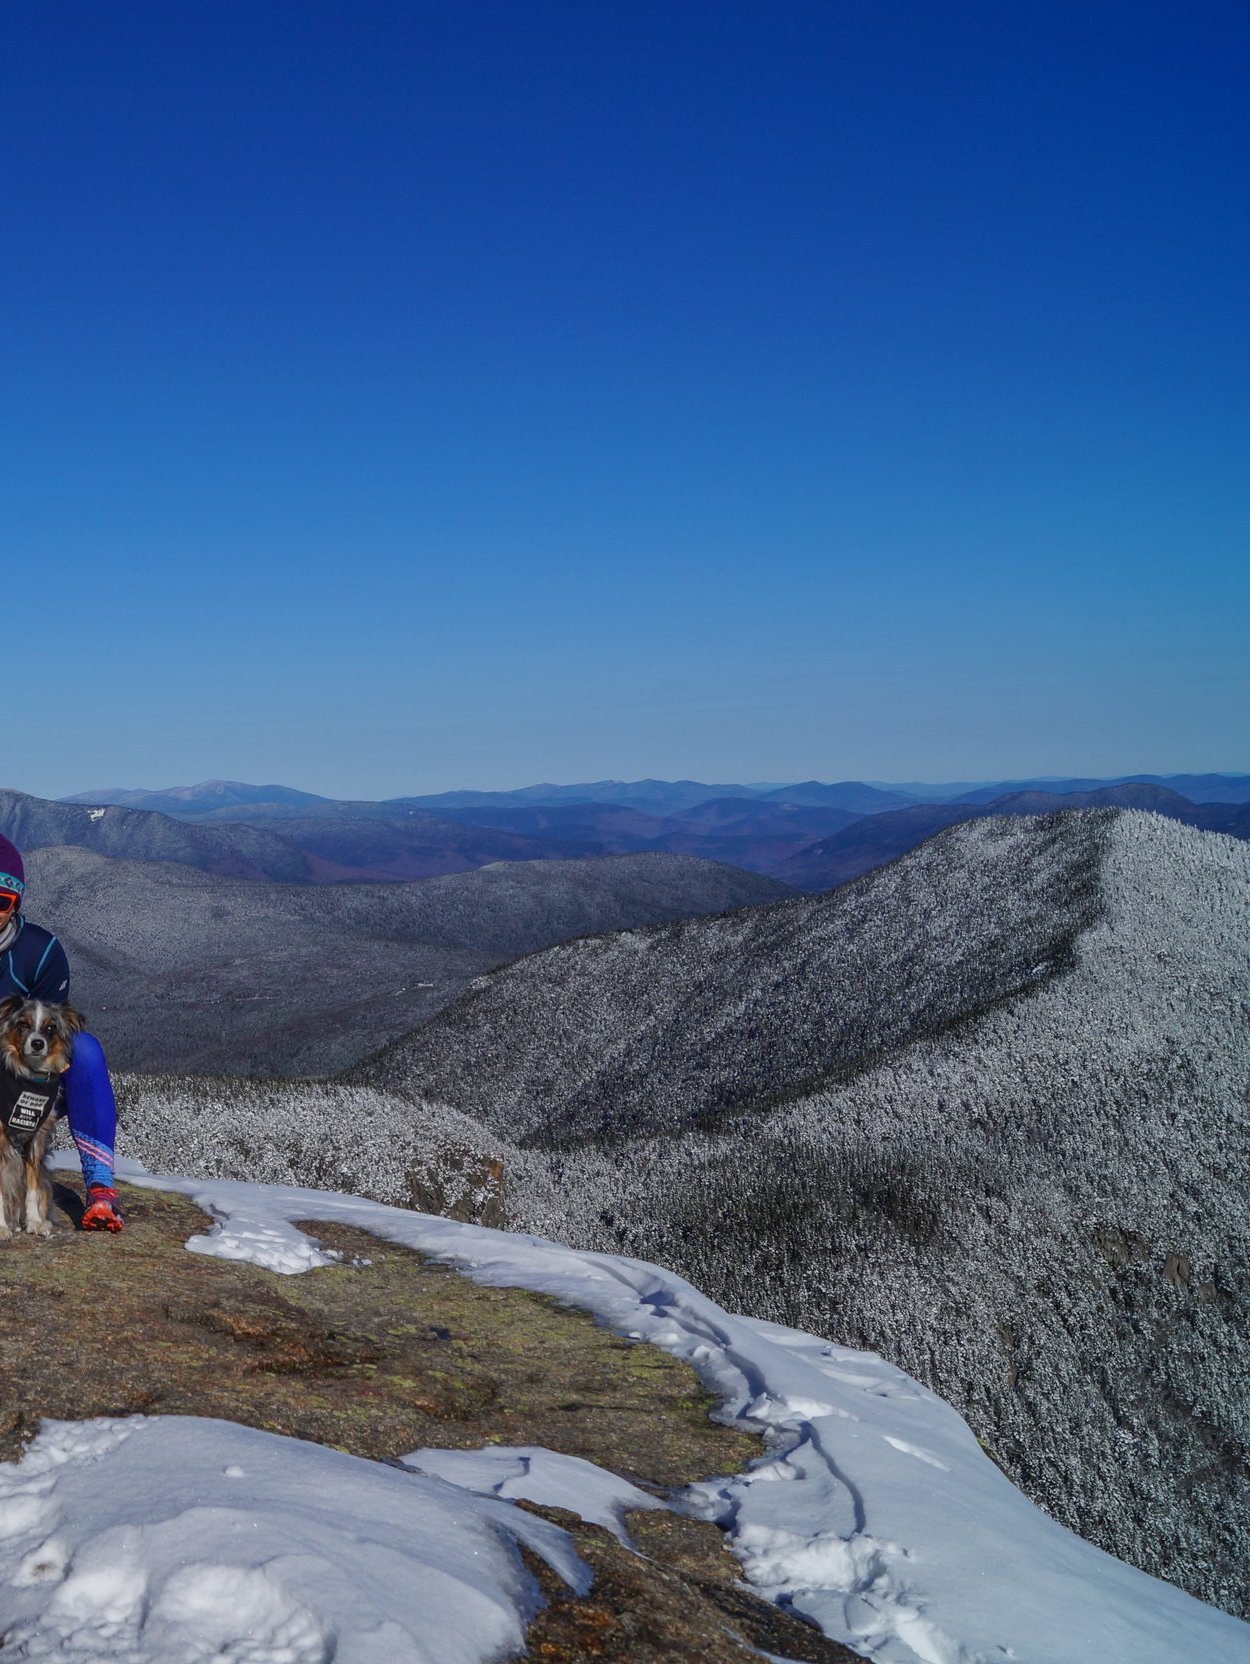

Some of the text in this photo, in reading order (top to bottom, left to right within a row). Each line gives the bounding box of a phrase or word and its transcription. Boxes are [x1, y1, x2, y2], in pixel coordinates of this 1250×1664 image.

[23, 1094, 46, 1102] BEWARE
[20, 1108, 35, 1116] WILL
[12, 1117, 35, 1127] RACISTS
